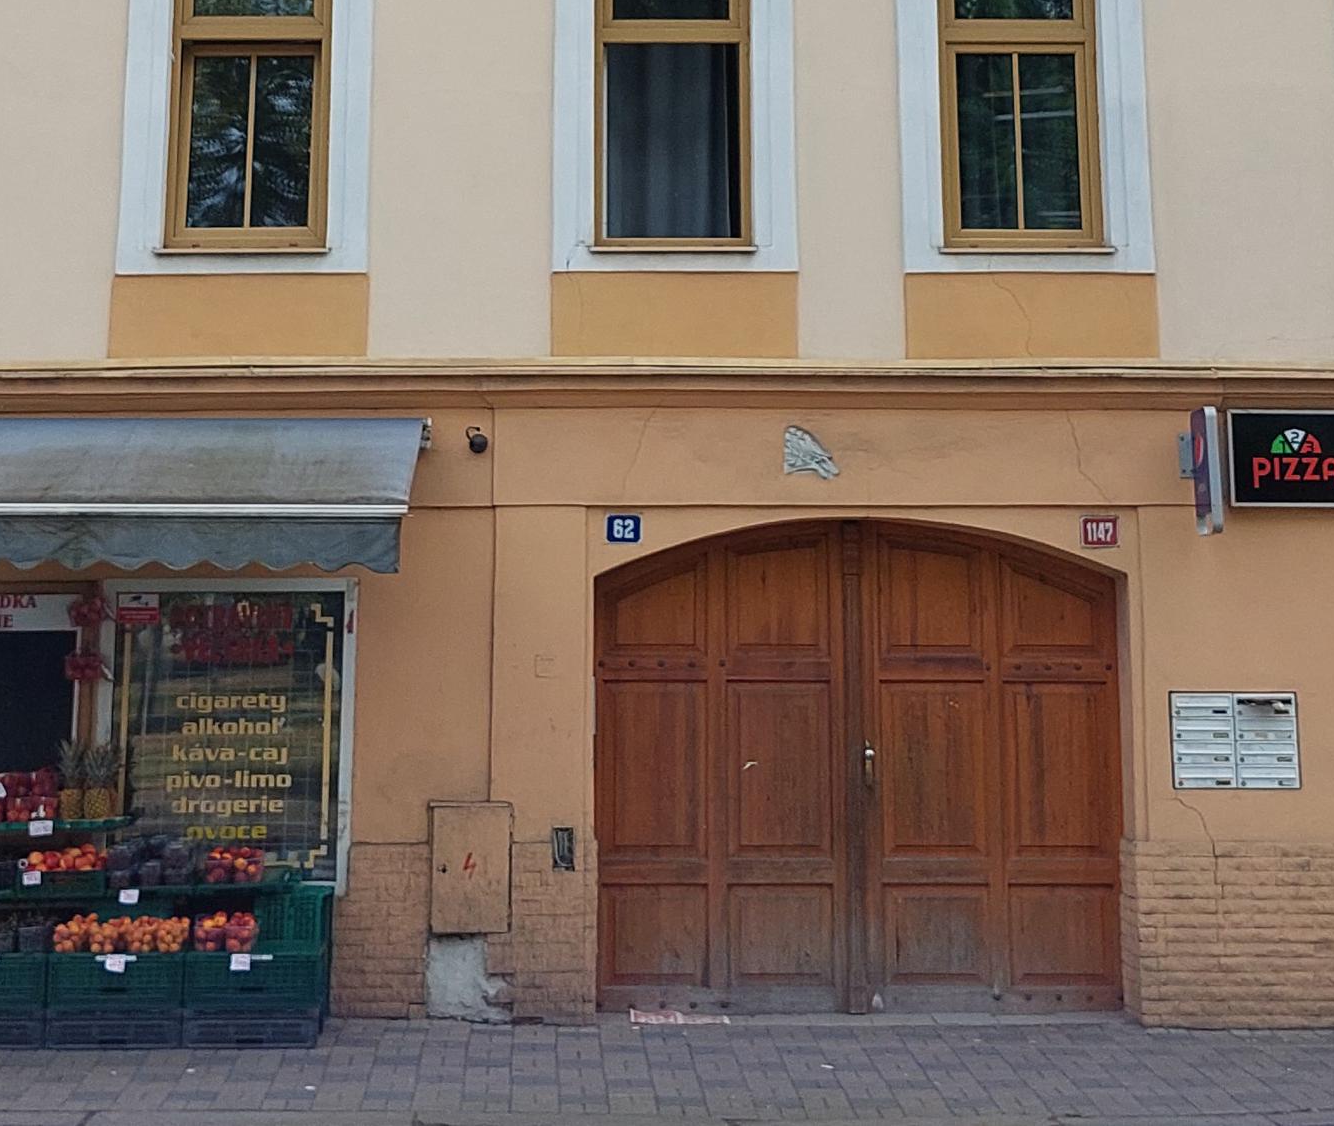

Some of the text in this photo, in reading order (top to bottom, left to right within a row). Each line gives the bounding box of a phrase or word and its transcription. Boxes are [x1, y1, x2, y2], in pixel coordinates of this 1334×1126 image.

[613, 518, 635, 539] 62
[1086, 521, 1113, 542] 1147
[175, 692, 287, 713] cigarety
[171, 795, 284, 817] drogerie
[185, 825, 268, 841] ovoce
